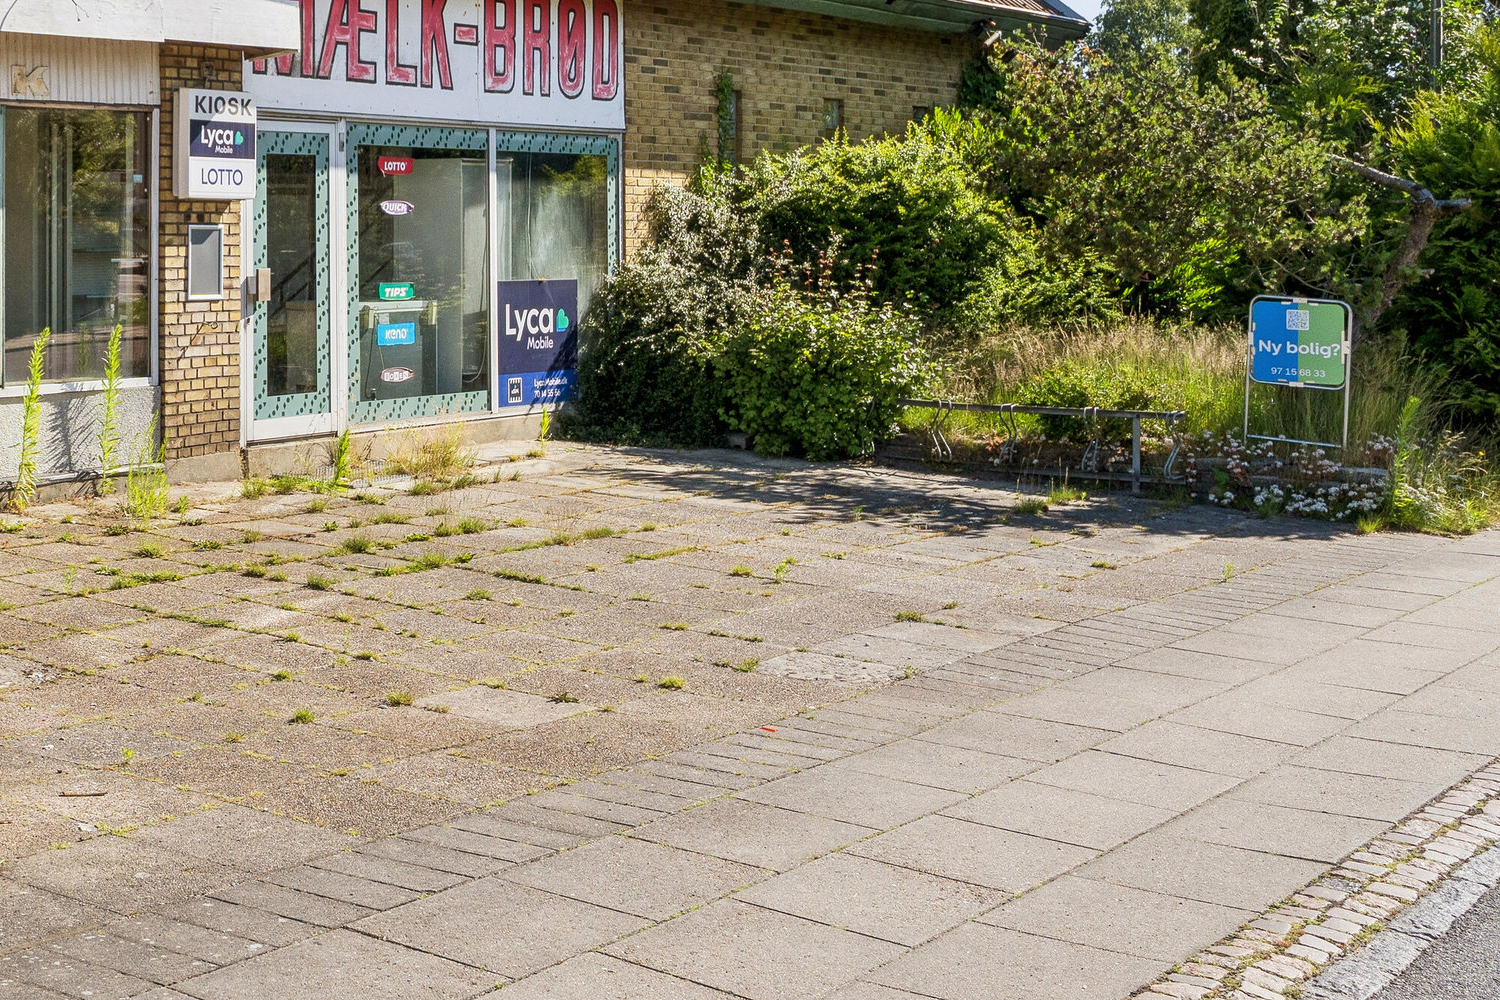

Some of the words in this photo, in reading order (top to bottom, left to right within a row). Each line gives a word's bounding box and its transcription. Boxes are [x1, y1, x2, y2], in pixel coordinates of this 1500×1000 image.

[194, 95, 253, 117] KIOSK
[200, 124, 234, 148] Lyca
[214, 145, 234, 154] Mobile
[384, 161, 406, 171] LOTTO
[201, 167, 244, 186] LOTTO
[382, 202, 408, 212] QUICK
[384, 287, 407, 298] TIPS
[505, 303, 554, 342] Lyca
[526, 335, 554, 350] Mobile
[1258, 339, 1282, 356] Ny
[1286, 341, 1340, 359] bolig?
[1270, 367, 1283, 375] 97
[1285, 368, 1297, 376] 15
[1299, 369, 1311, 377] 68
[1313, 369, 1326, 378] 33
